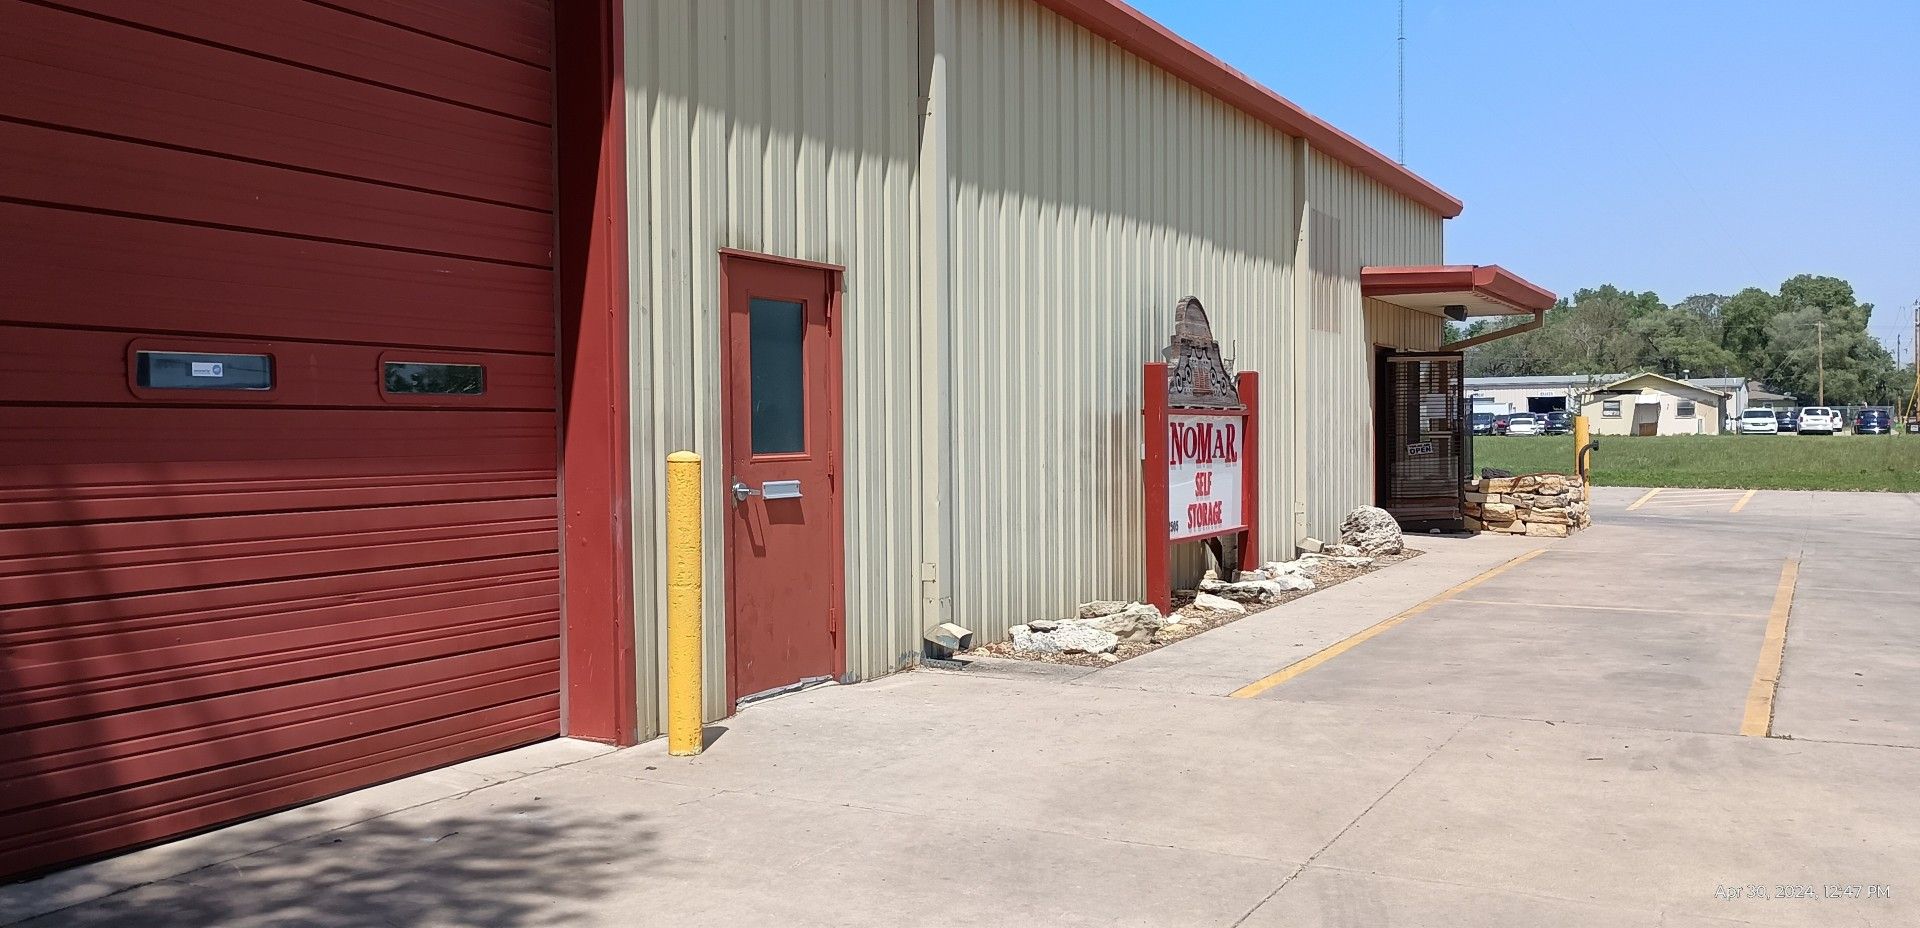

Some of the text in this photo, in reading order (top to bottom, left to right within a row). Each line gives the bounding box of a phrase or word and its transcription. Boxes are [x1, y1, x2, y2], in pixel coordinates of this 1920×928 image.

[1409, 445, 1431, 455] OPEN
[1195, 472, 1212, 497] SELF
[1187, 501, 1222, 529] STORAGE
